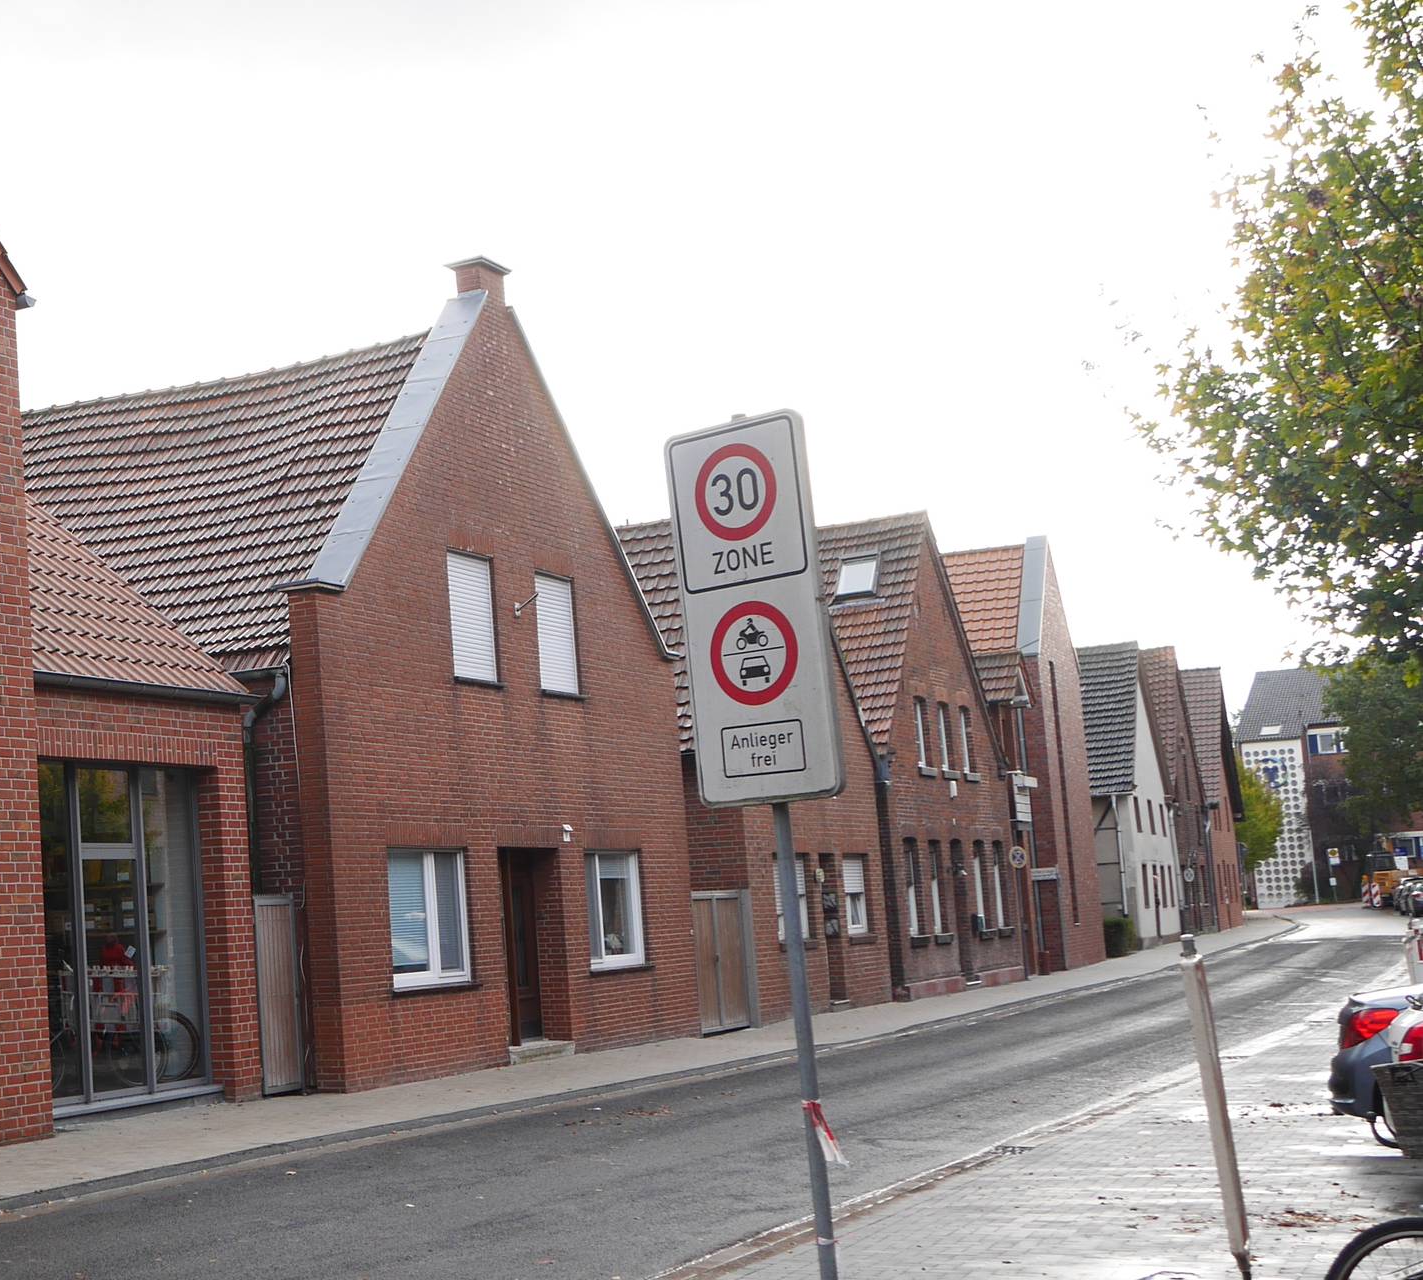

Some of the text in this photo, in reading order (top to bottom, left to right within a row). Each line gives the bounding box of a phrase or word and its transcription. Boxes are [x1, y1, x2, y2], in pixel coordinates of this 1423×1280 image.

[710, 467, 760, 518] 30
[712, 541, 775, 575] ZONE
[730, 730, 793, 752] Anlieger
[750, 752, 777, 768] frei
